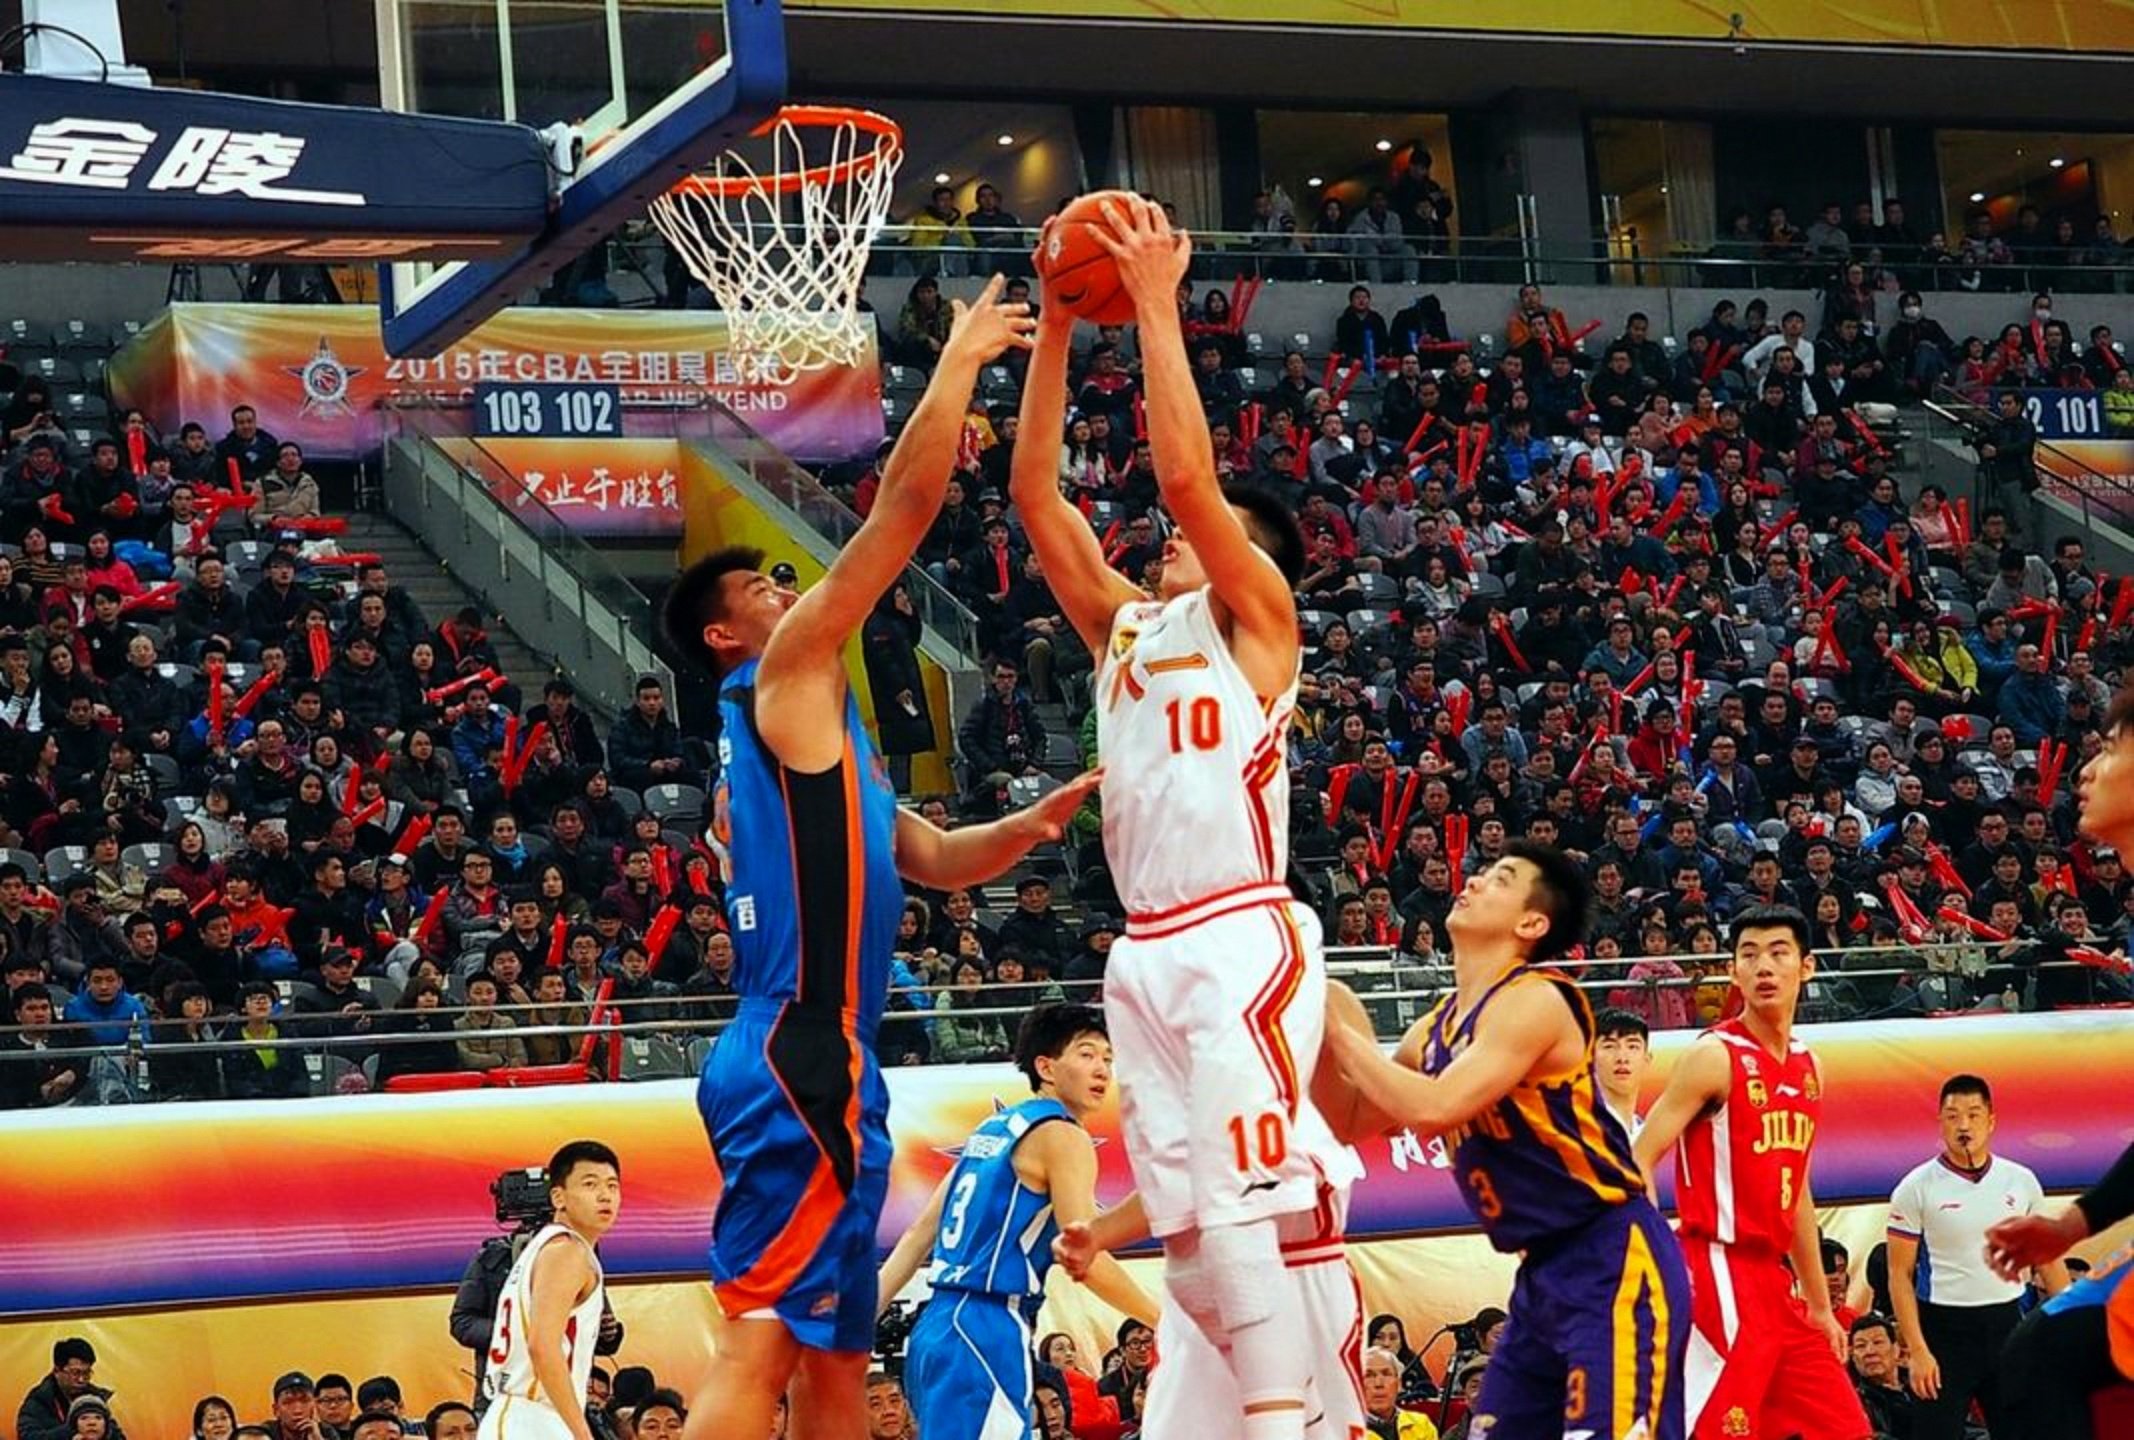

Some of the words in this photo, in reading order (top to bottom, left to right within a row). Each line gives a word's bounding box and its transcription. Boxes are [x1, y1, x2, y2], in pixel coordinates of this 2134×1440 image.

[0, 117, 366, 205] 金陵
[484, 390, 543, 433] 103
[555, 390, 613, 432] 102
[2056, 397, 2100, 433] 101
[1165, 696, 1222, 755] 10
[1228, 1112, 1287, 1172] 10
[940, 1172, 978, 1249] 3
[1468, 1168, 1502, 1218] 3
[490, 1297, 513, 1365] 3
[1565, 1367, 1588, 1421] 3
